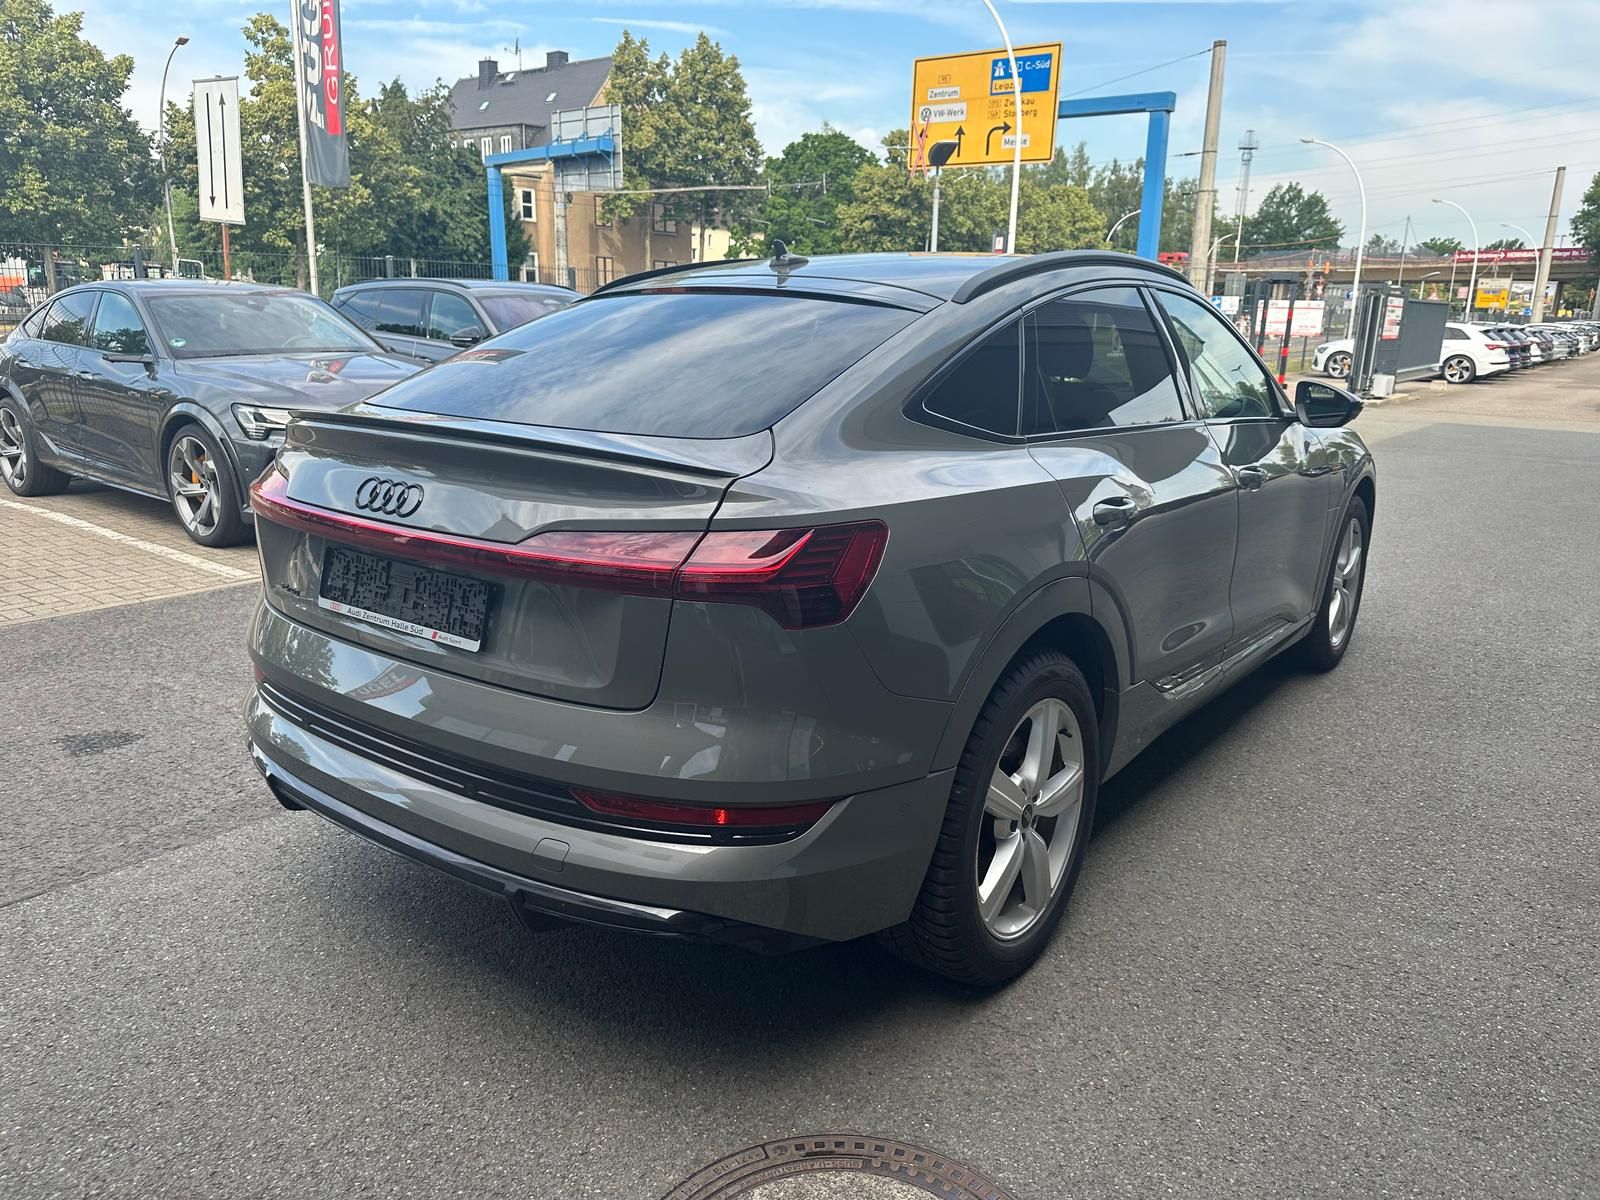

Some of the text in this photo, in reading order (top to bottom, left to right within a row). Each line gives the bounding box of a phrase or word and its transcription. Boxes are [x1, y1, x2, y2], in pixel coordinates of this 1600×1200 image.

[1025, 59, 1050, 70] C.-Süd
[994, 81, 1020, 92] Leipz
[929, 89, 958, 99] Zentrum
[1004, 97, 1035, 108] Zwkau
[933, 108, 964, 118] VW-Werk
[1003, 108, 1038, 119] Stoberg
[1004, 137, 1027, 147] Mee
[347, 607, 424, 635] Audi Zentrum Halle Süd
